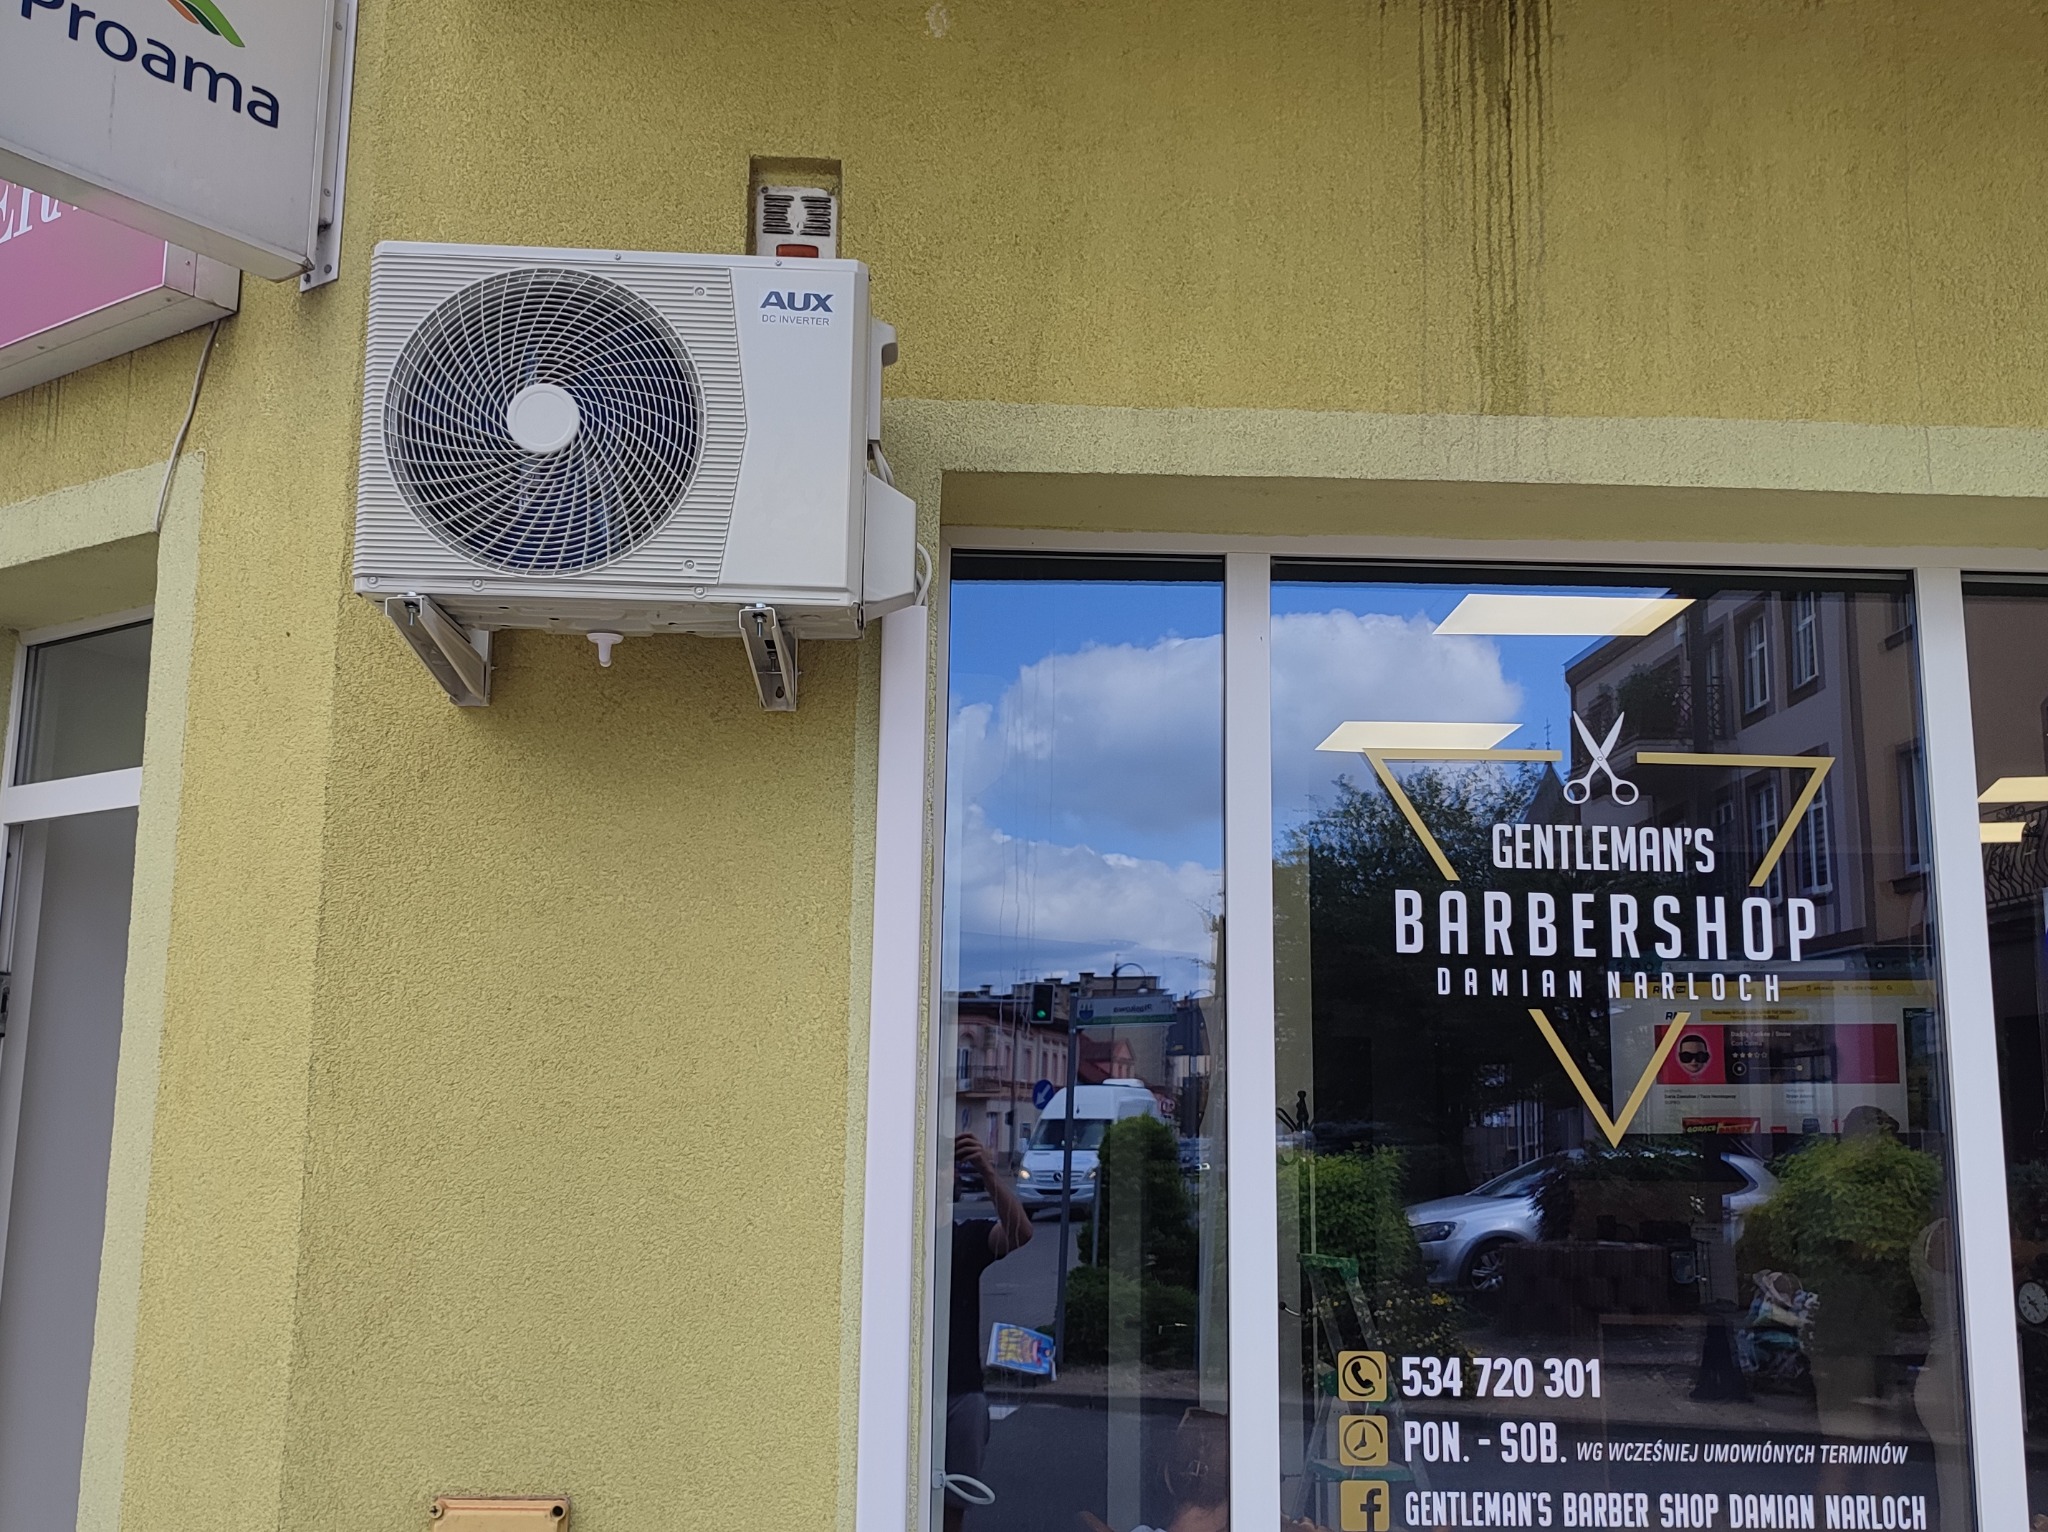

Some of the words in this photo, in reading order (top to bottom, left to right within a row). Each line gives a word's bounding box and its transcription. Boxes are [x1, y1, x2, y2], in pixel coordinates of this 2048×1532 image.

[760, 290, 833, 313] AUX
[761, 314, 777, 323] DC
[779, 315, 830, 326] INVERTER
[1491, 822, 1715, 873] GENTLEMAN'S
[1394, 888, 1817, 962] BARBERSHOP
[1437, 966, 1583, 999] DAMIAN
[1607, 970, 1780, 1003] NARLOCH
[1401, 1356, 1464, 1398] 534
[1472, 1357, 1534, 1398] 720
[1543, 1357, 1601, 1398] 301
[1403, 1420, 1470, 1463] PON.
[1500, 1421, 1567, 1464] SOB.
[1576, 1441, 1603, 1462] WG
[1608, 1439, 1699, 1463] WCZEŚNIEJ
[1703, 1440, 1815, 1464] UMOWIÓNYCH
[1820, 1441, 1909, 1465] TERMINÓW
[1405, 1490, 1553, 1528] GENTLEMAN'S
[1562, 1492, 1650, 1529] BARBER
[1659, 1492, 1719, 1529] SHOP
[1728, 1493, 1816, 1530] DAMIAN
[1825, 1494, 1928, 1532] NARLOCH
